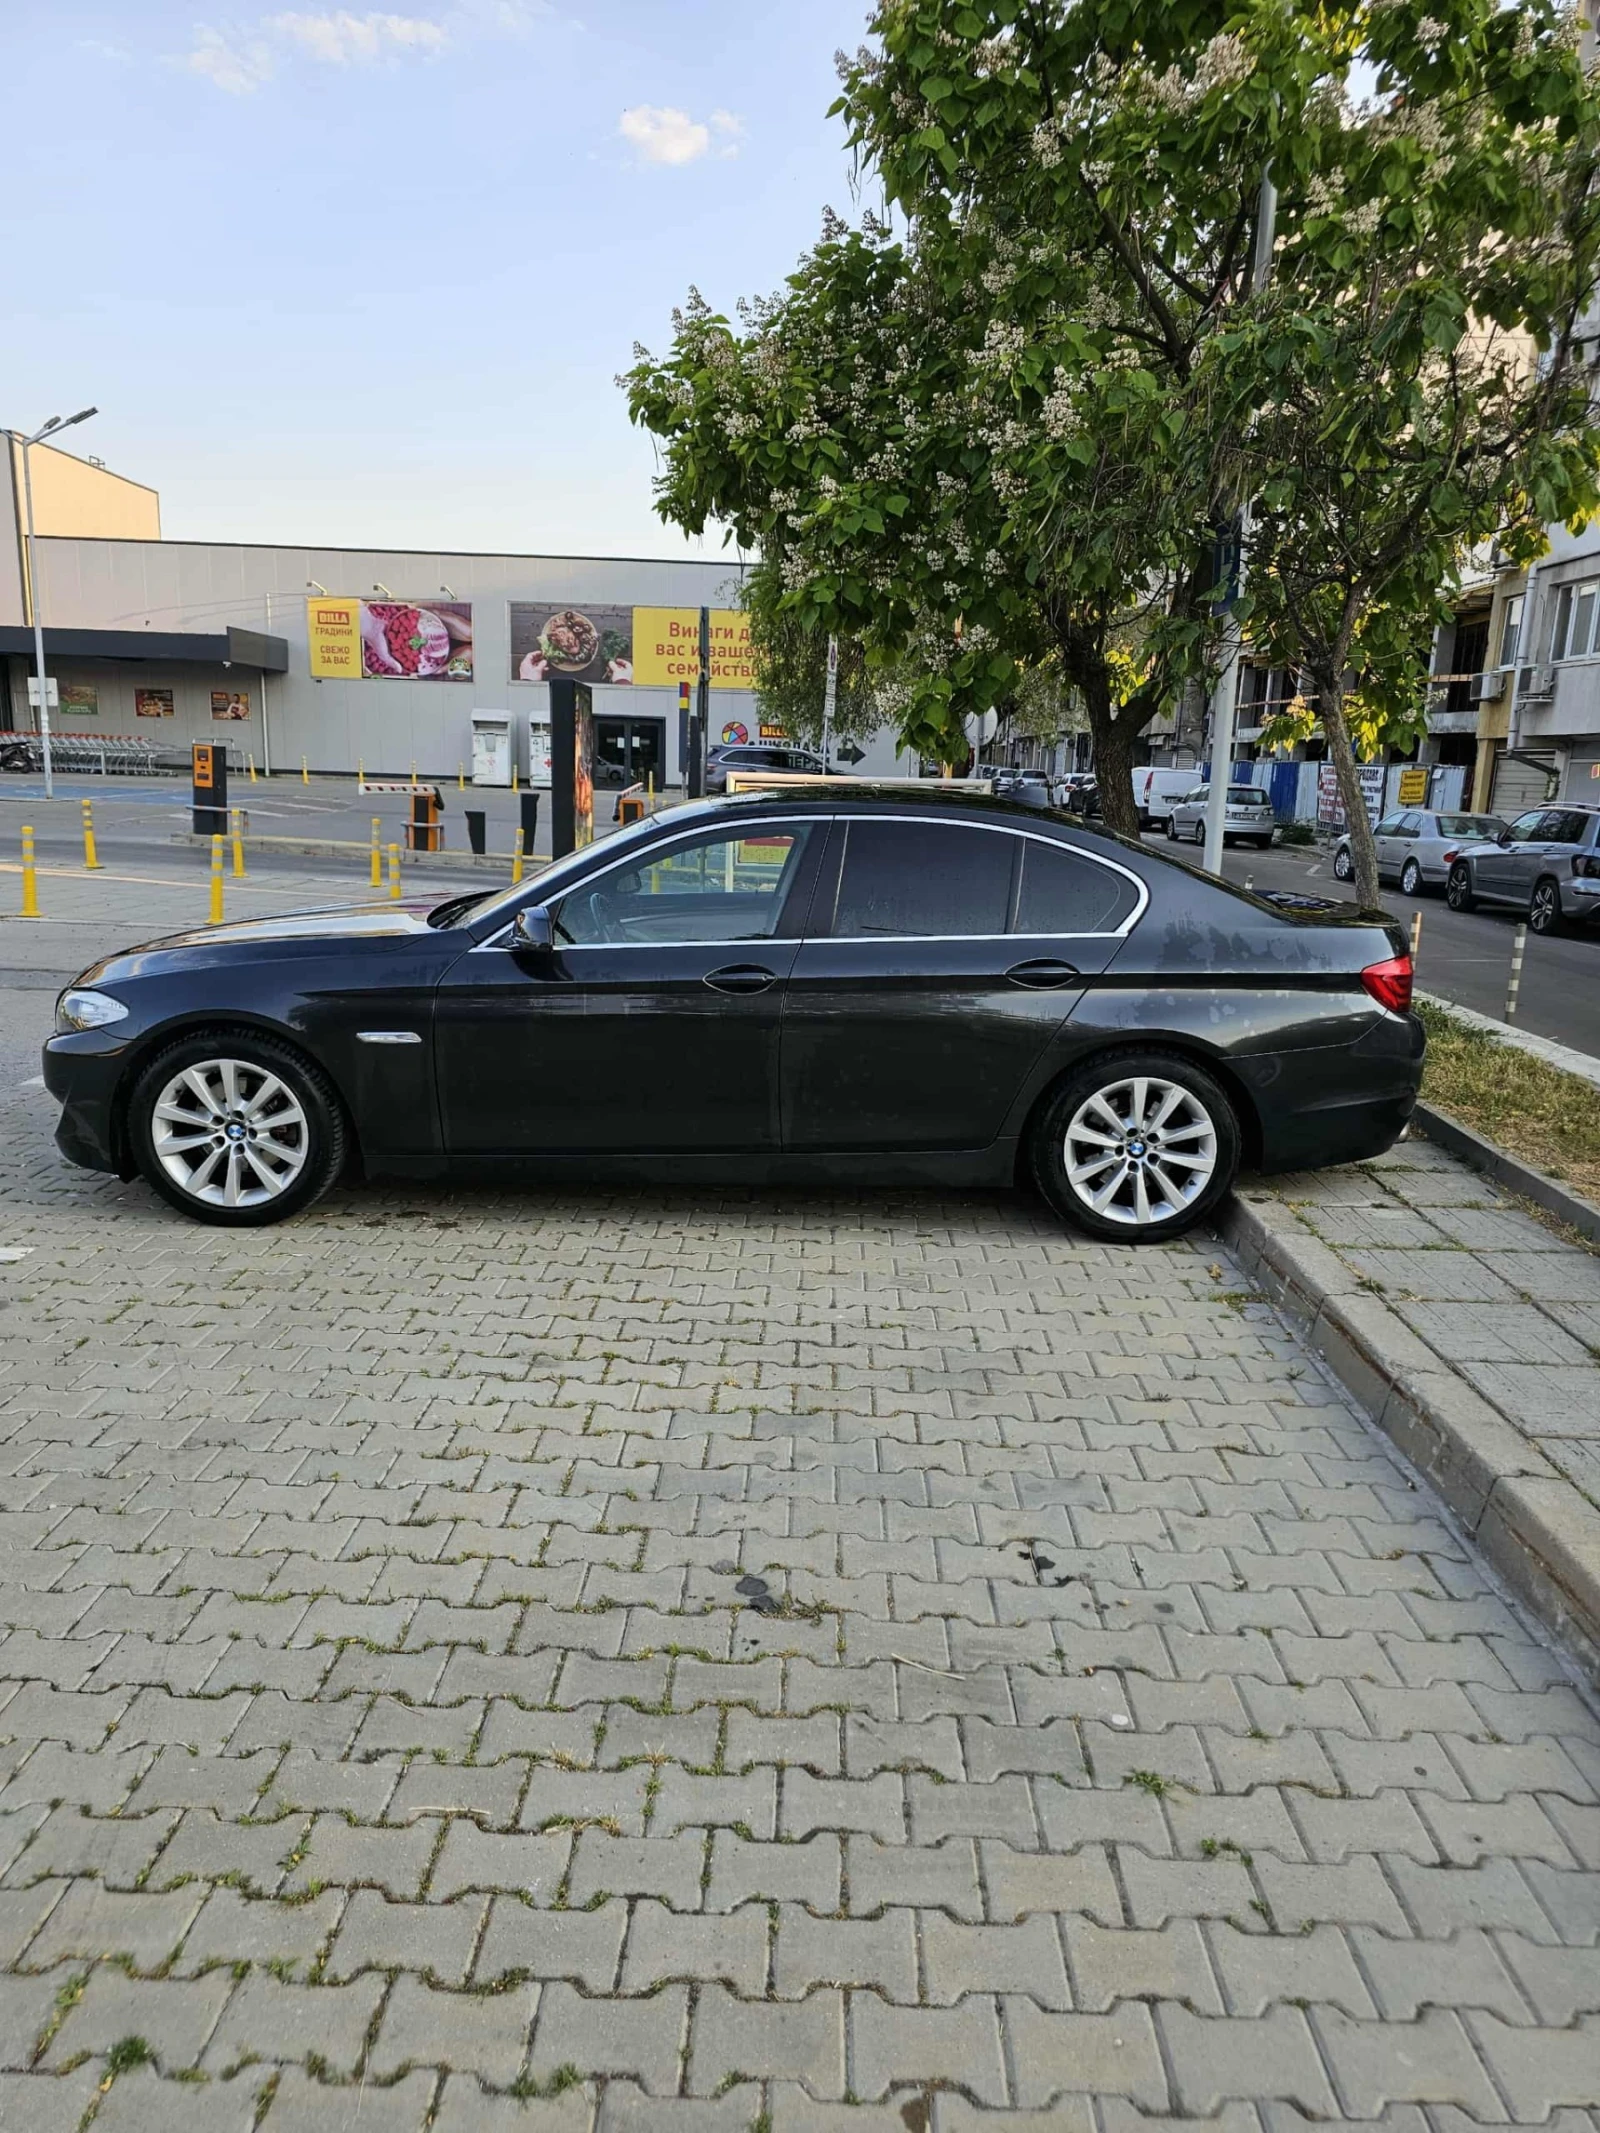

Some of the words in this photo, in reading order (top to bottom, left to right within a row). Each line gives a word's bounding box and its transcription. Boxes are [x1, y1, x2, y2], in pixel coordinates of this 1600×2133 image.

[319, 612, 348, 624] BILLA
[315, 627, 352, 637] ГРАДИНИ
[320, 645, 350, 655] СВЕЖО
[656, 644, 685, 656] вас
[708, 646, 767, 659] ваше
[320, 655, 332, 664] ЗА
[333, 656, 350, 665] ВАС
[667, 660, 759, 677] семйство
